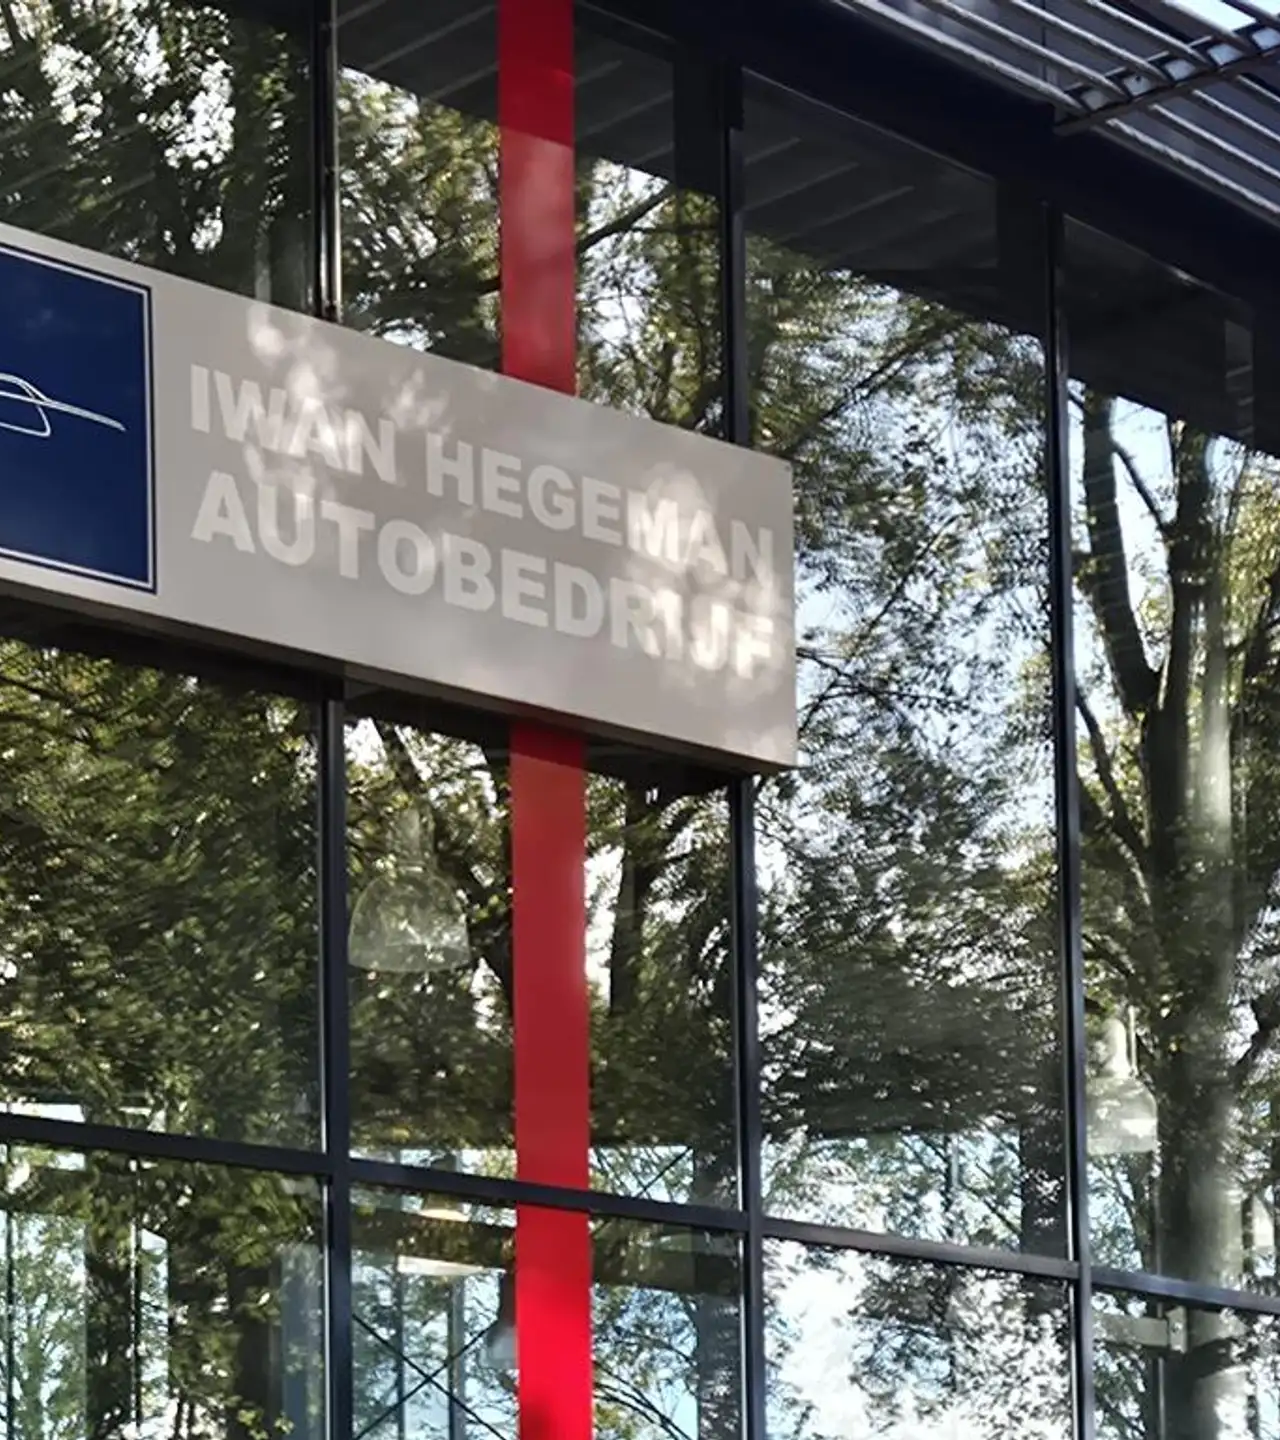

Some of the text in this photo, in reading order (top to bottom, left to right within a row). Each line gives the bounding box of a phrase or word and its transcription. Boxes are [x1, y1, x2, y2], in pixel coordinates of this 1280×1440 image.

[190, 470, 774, 680] AUTOBEDRIJF
[191, 363, 774, 590] IWAN HEGEMAN
